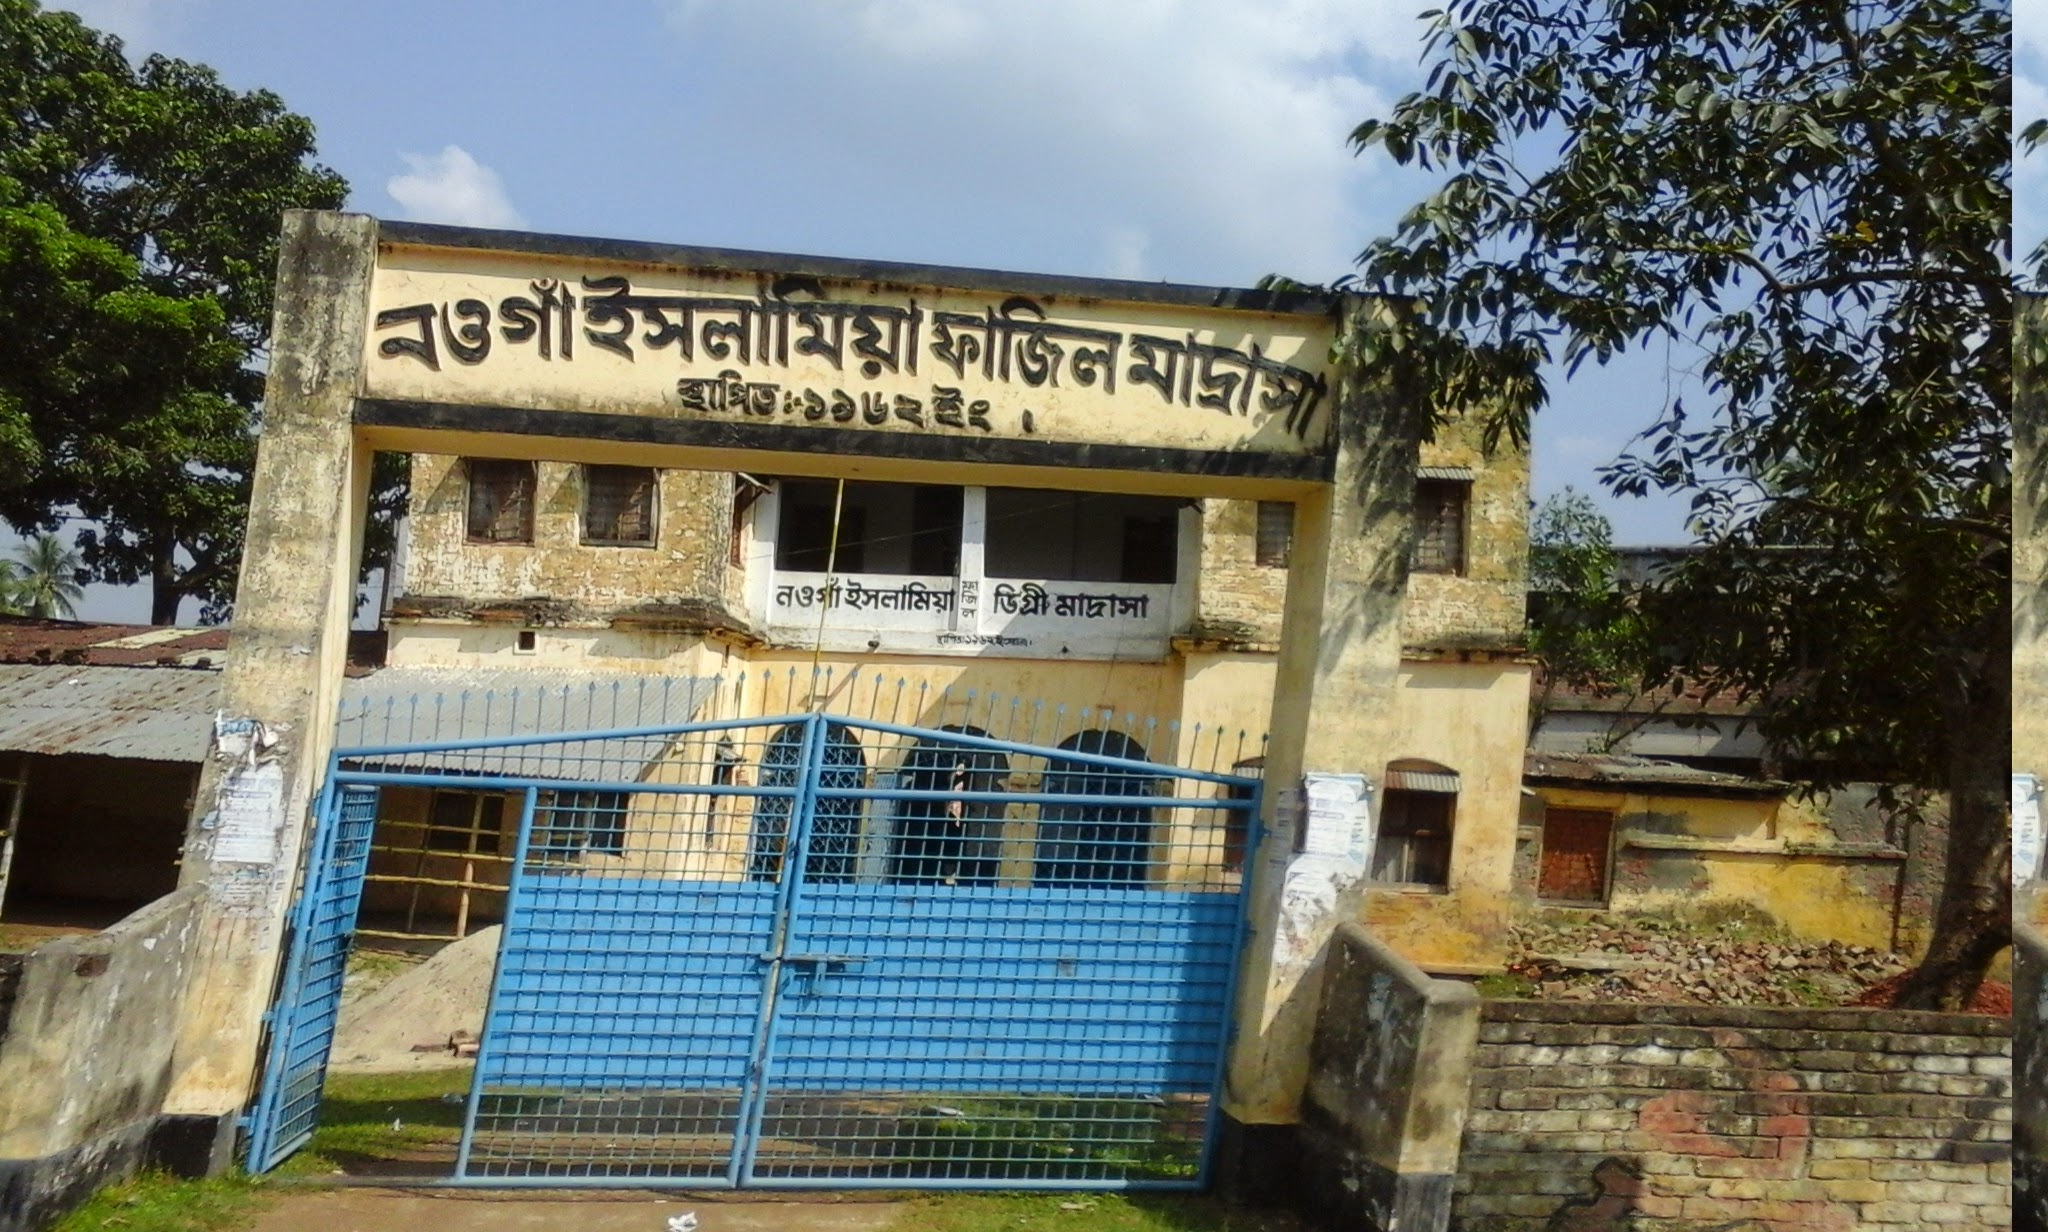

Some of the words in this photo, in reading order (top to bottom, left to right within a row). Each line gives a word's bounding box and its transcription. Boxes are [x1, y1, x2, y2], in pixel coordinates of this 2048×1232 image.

[374, 278, 575, 372] নওগাঁ
[929, 296, 1123, 395] ফাজিল
[1126, 332, 1328, 441] মাদ্রাসা
[776, 577, 842, 610] নওগাঁ
[1055, 592, 1150, 619] মাদ্রাসা
